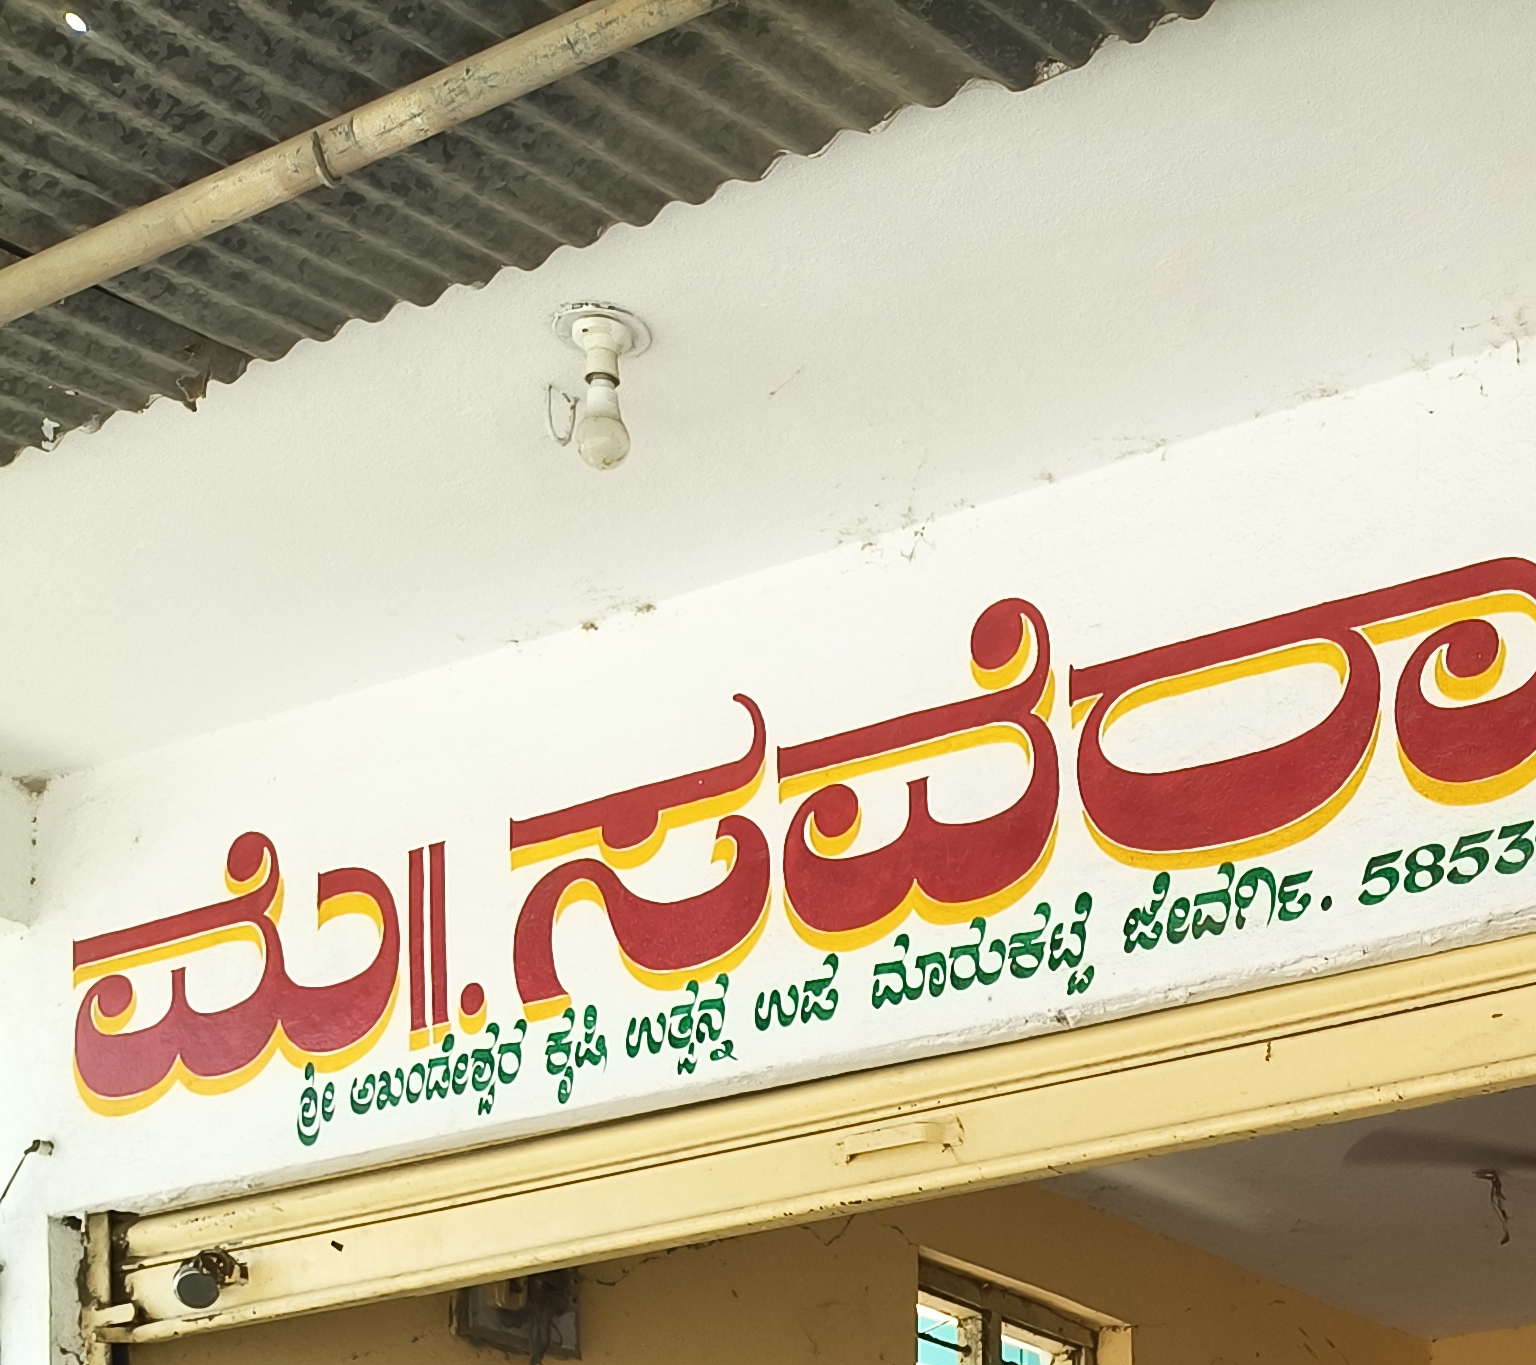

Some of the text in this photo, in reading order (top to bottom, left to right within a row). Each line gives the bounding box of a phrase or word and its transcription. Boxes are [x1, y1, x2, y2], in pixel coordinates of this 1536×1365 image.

[297, 1062, 336, 1146] ಶ್ರೀ
[350, 1019, 528, 1115] ಅಖಂಡೇಶ್ವರ
[545, 1004, 608, 1104] ಕೃಷಿ
[625, 974, 739, 1075] ಉತ್ಪನ್ನ
[754, 953, 839, 1031] ಉಪ
[871, 891, 1095, 1010] ಮಾರುಕಟ್ಟೆ
